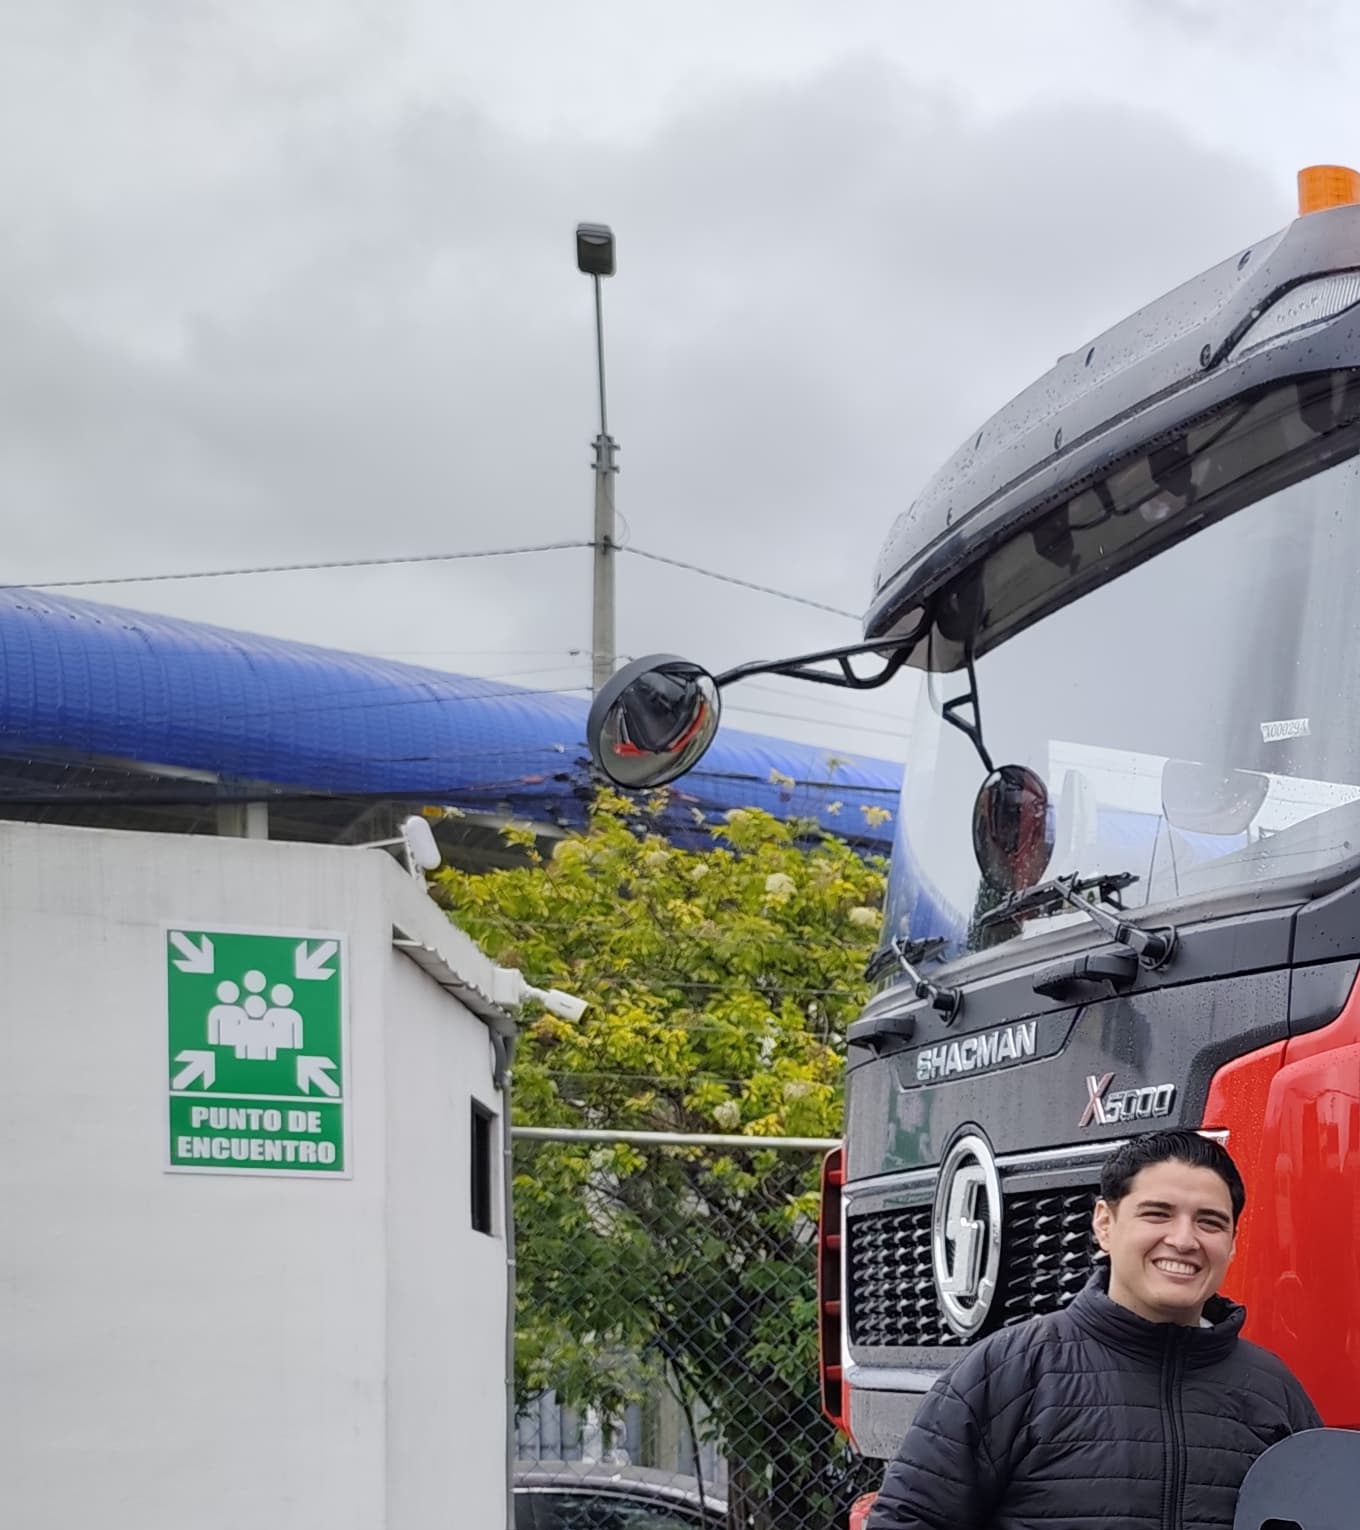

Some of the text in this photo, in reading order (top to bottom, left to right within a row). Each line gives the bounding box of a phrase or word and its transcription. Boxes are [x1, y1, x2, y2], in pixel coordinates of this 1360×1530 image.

[916, 1021, 1037, 1081] SHACMAN
[191, 1106, 322, 1133] PUNTO DE
[1078, 1072, 1177, 1128] X5000
[177, 1136, 336, 1164] ENCUENTRO
